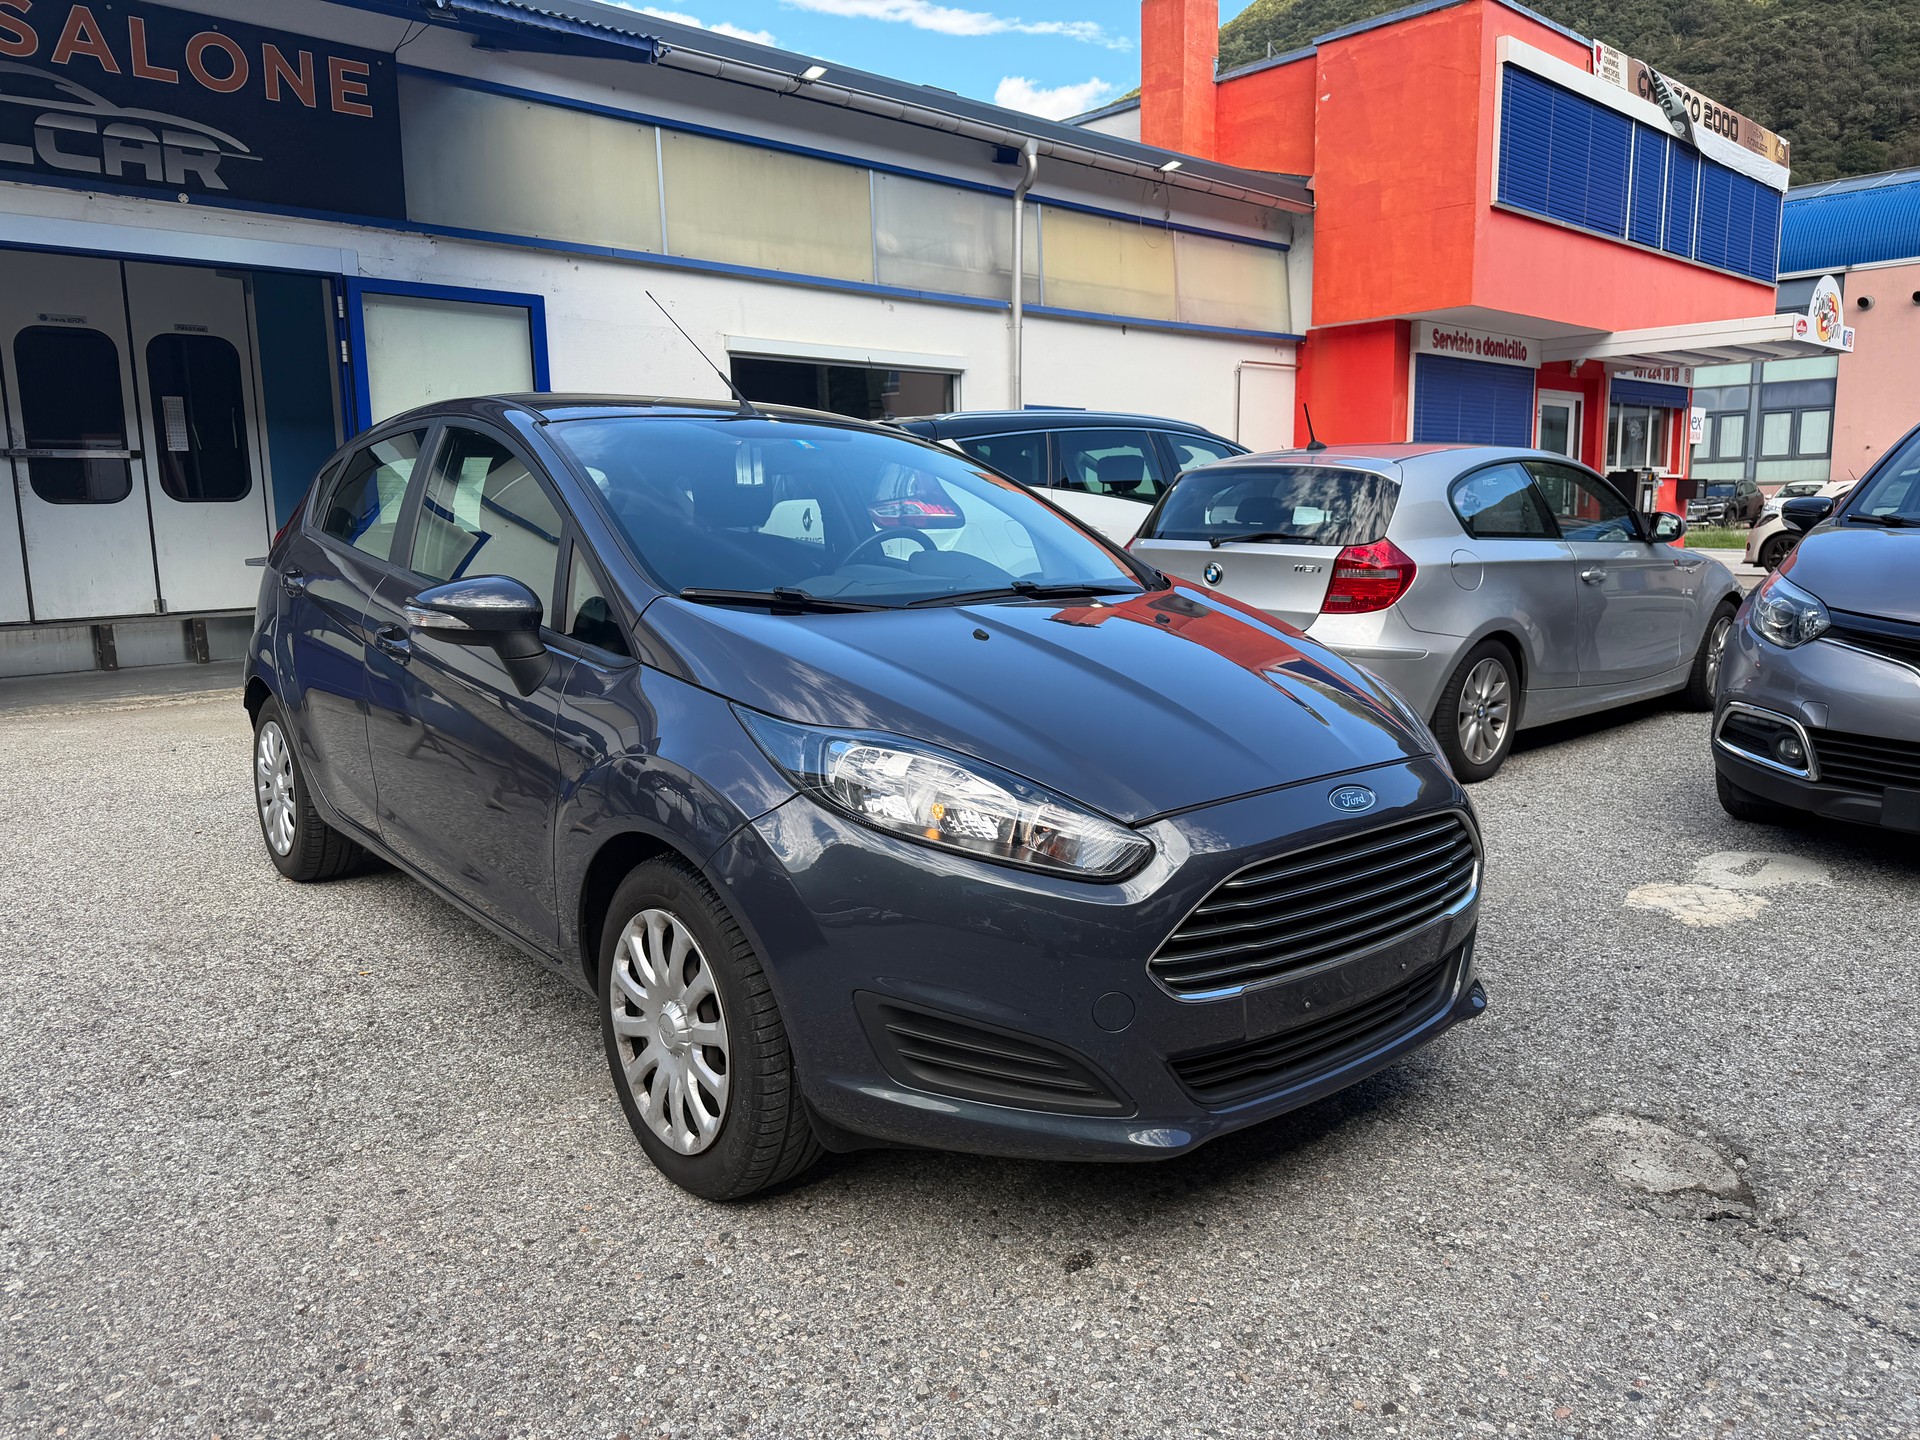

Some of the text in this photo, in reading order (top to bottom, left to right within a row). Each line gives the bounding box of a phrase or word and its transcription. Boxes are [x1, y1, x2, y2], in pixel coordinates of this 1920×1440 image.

[0, 0, 374, 118] SALONE
[1703, 101, 1739, 142] 2000
[1432, 328, 1527, 361] Servizio a domicilio
[1340, 791, 1367, 807] Ford
